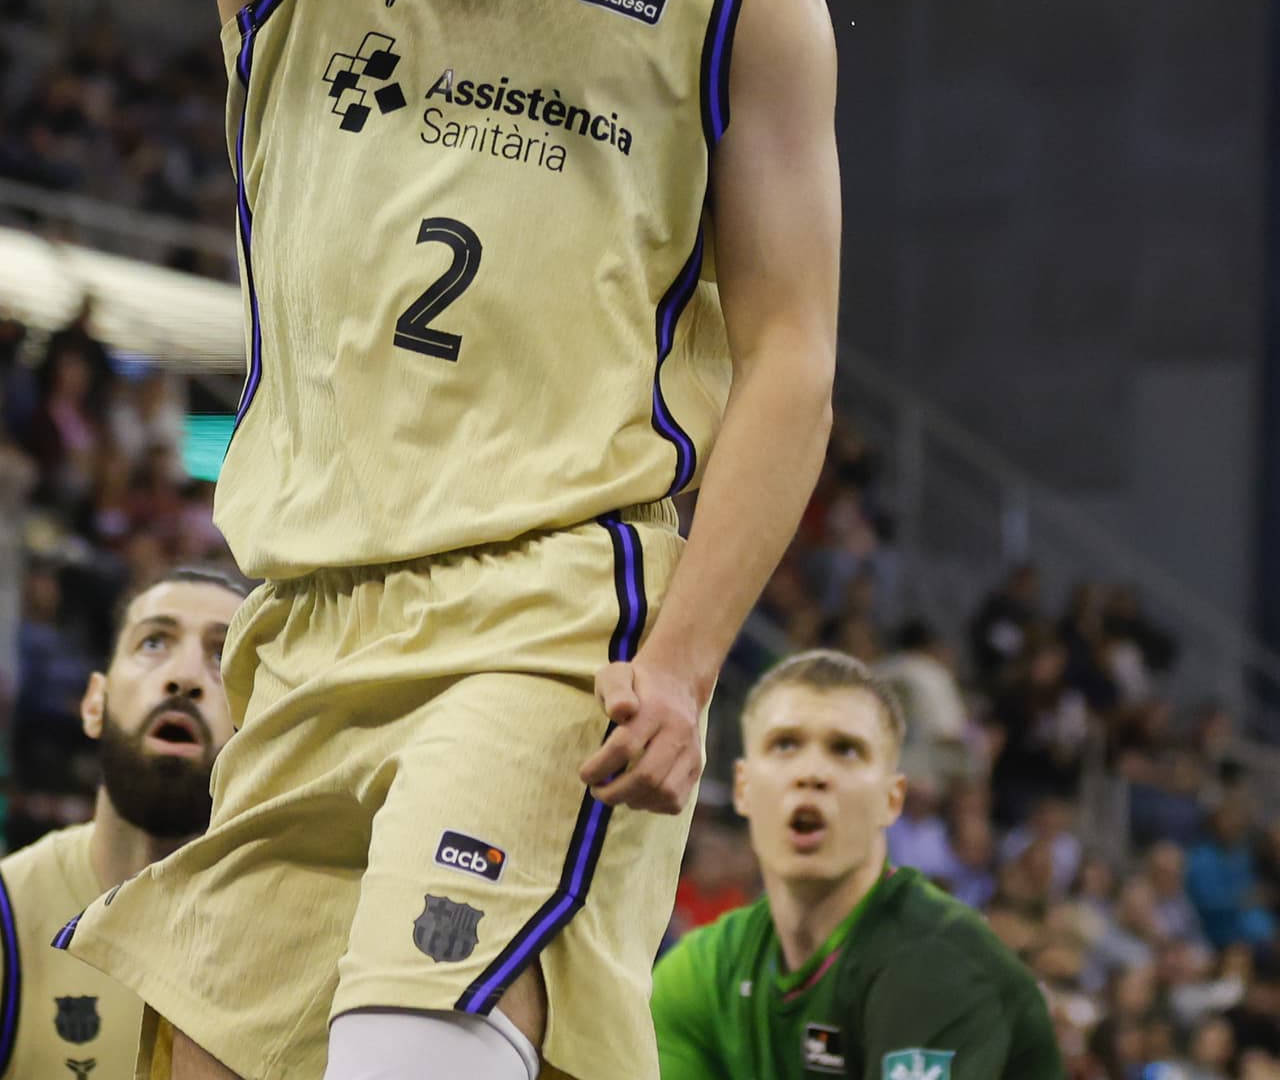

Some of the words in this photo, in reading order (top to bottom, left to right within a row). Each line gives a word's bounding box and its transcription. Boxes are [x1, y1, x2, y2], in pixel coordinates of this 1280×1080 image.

[420, 107, 568, 174] Sanitària
[424, 68, 634, 156] Assistència
[393, 216, 484, 363] 2
[440, 845, 489, 873] acb
